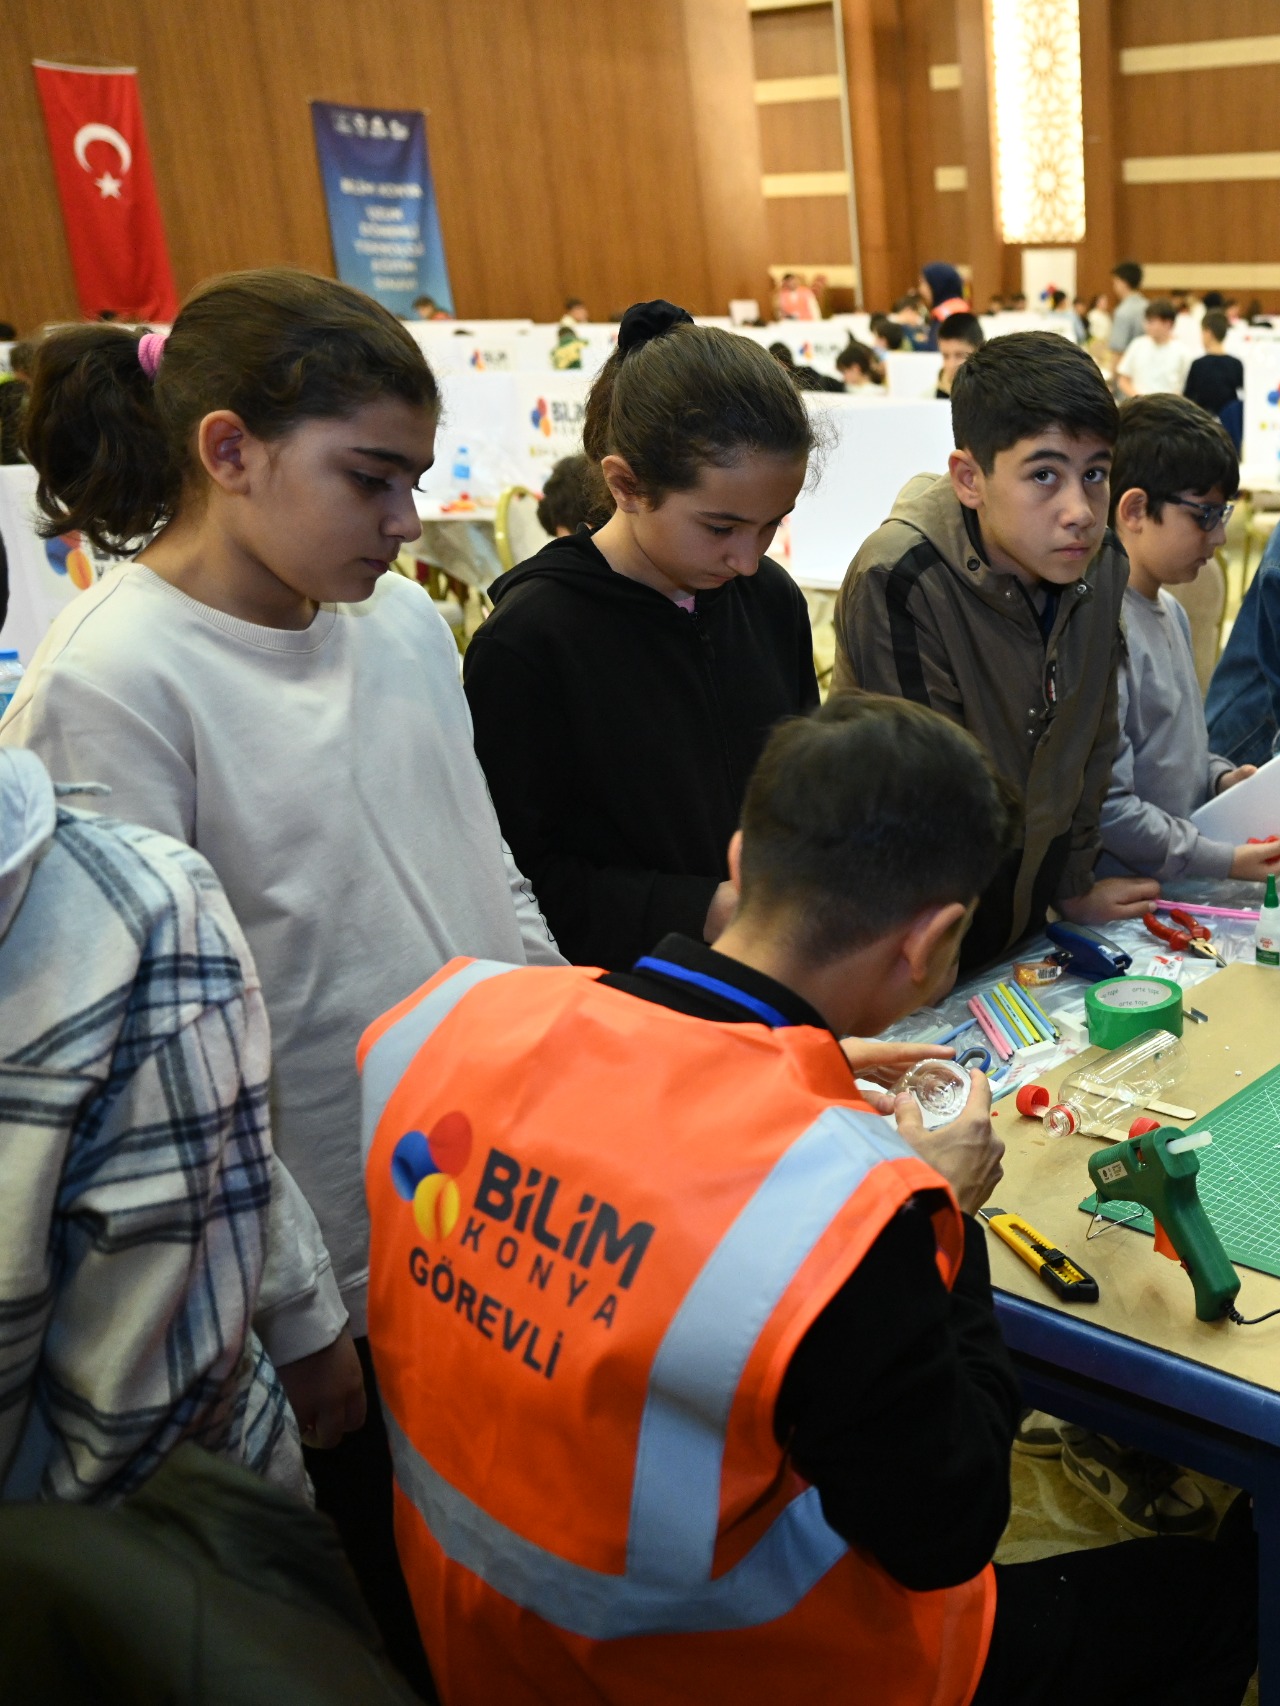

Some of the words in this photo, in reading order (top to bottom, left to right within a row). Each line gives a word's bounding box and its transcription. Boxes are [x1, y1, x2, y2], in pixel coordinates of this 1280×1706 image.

[460, 1216, 619, 1329] KONYA
[473, 1147, 656, 1291] BİLİM
[408, 1246, 564, 1380] GÖREVLİ
